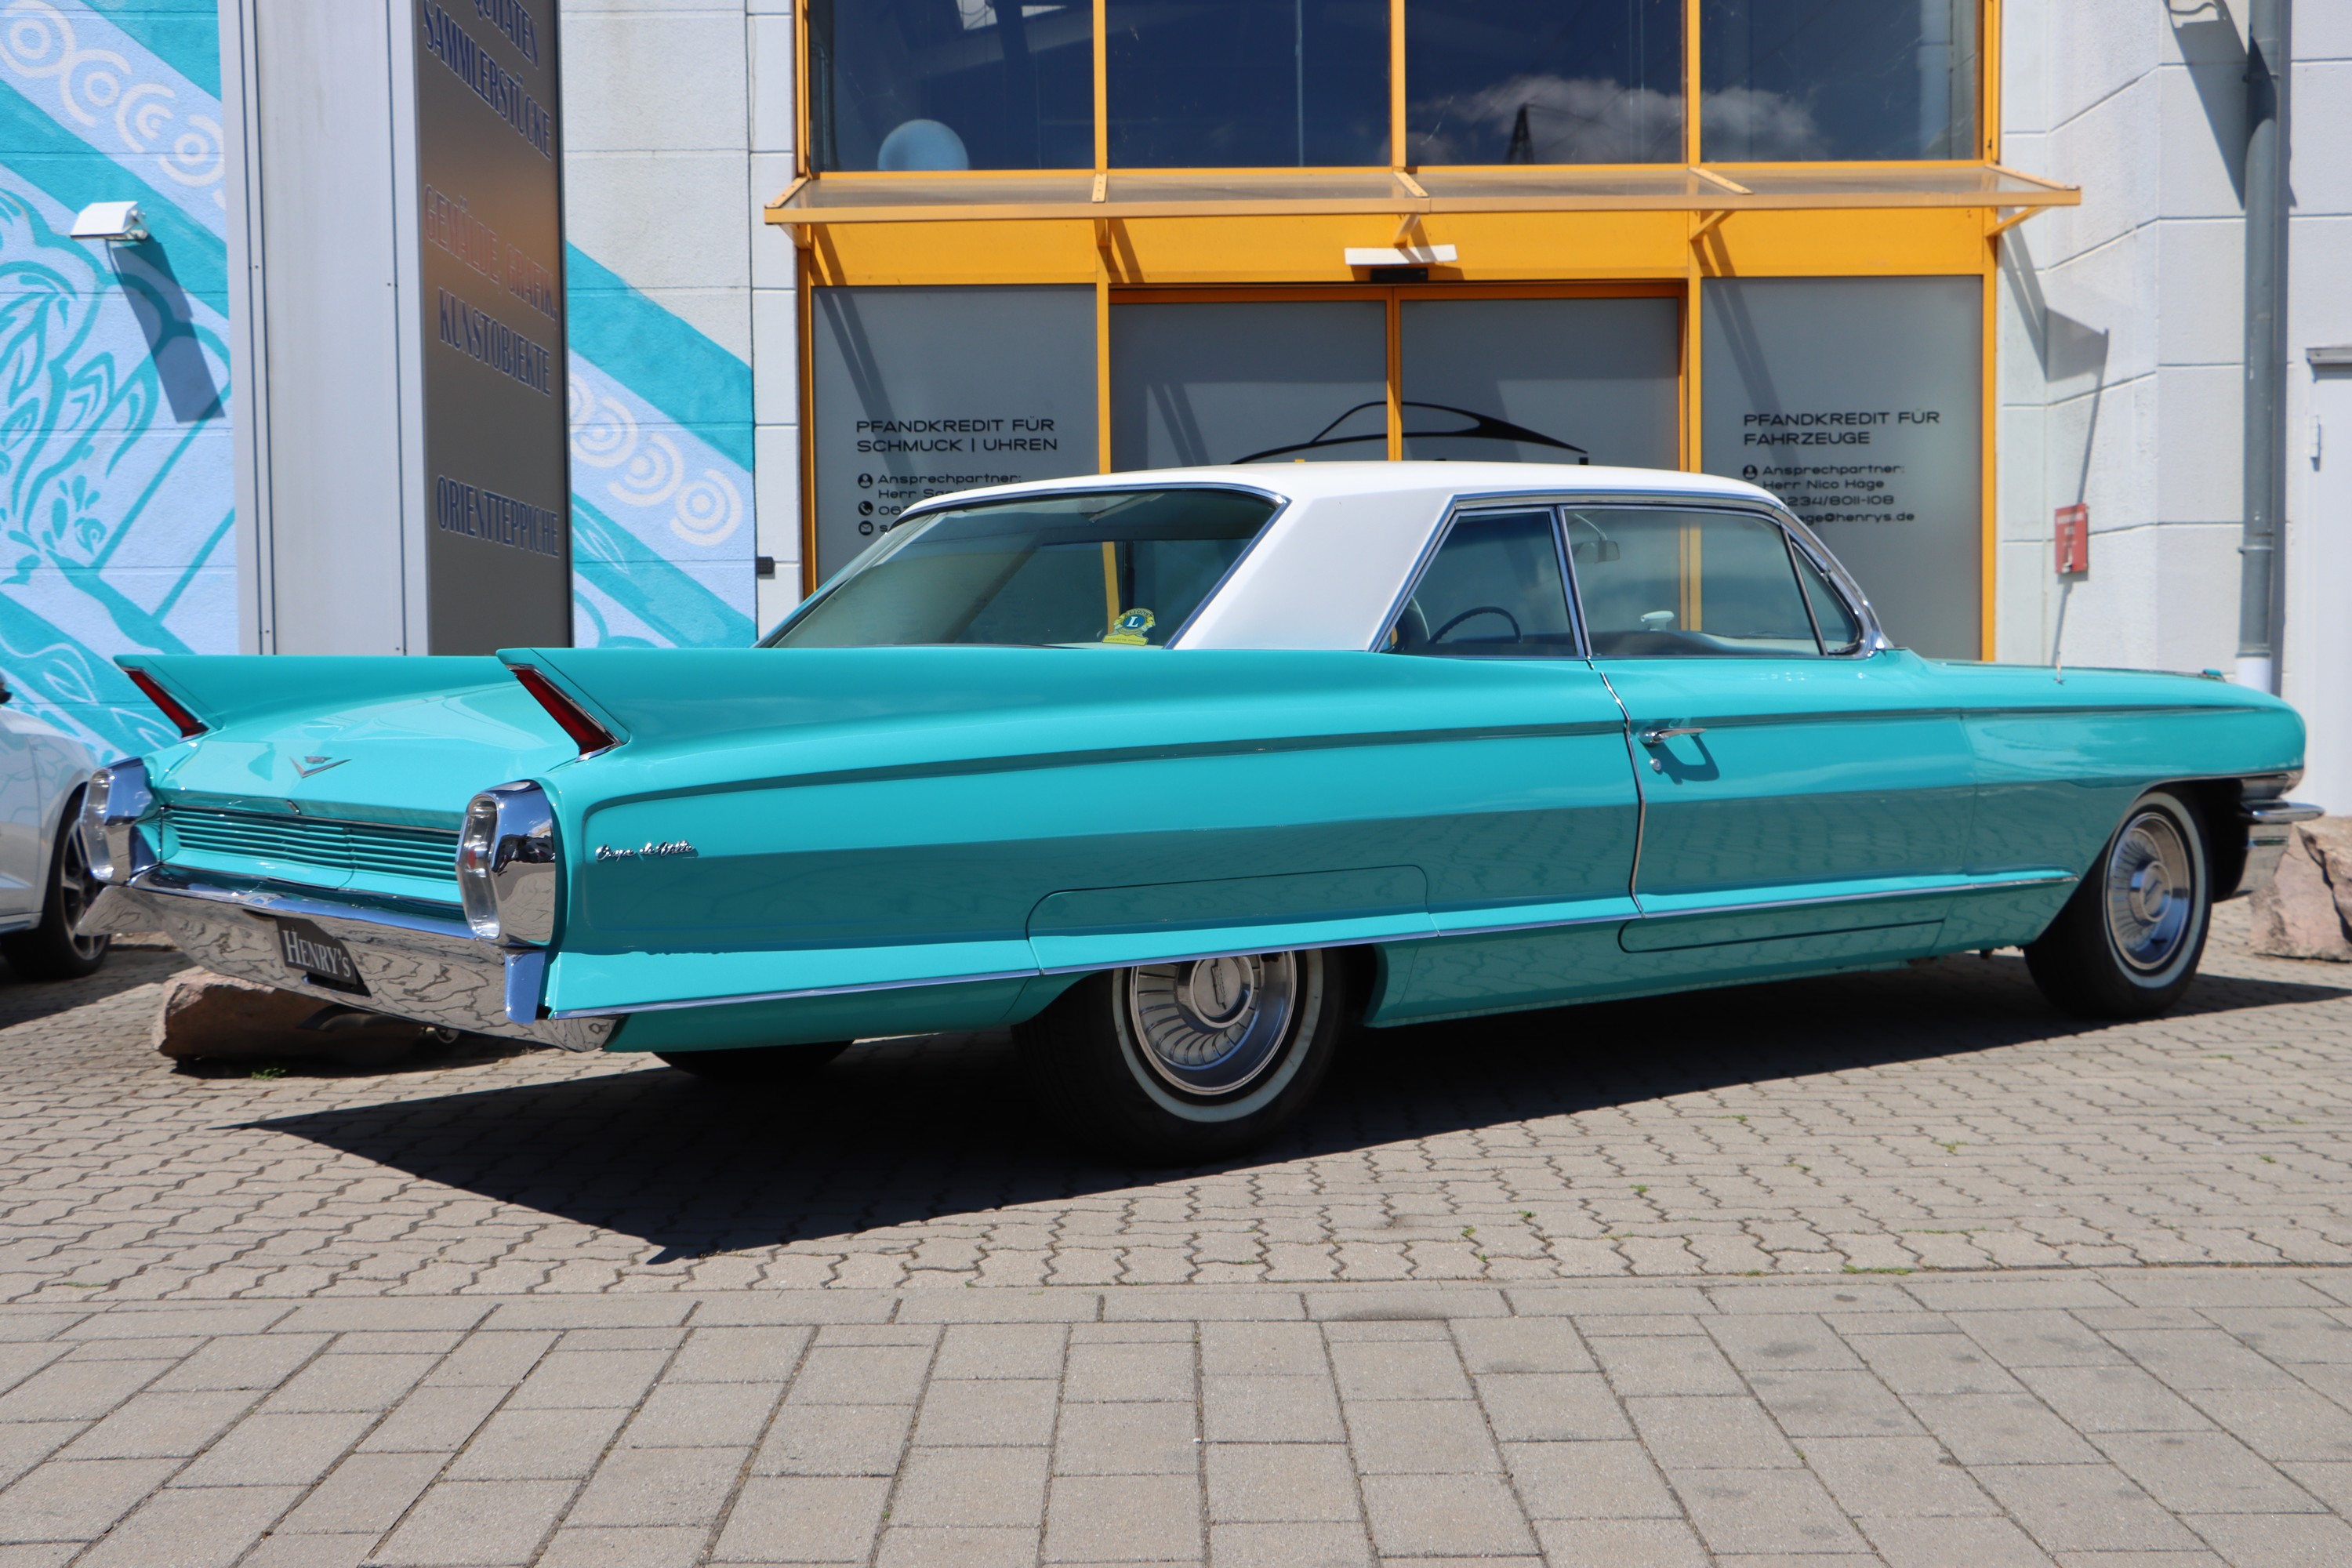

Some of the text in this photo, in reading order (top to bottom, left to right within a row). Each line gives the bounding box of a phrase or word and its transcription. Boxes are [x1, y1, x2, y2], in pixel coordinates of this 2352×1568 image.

[423, 0, 552, 162] SAMMLERSTÜCKE
[425, 183, 502, 295] GEMÄLDE,
[438, 286, 551, 397] KUNSTOBJEKTE
[1744, 408, 1940, 426] PFANDKREDIT FÜR
[856, 416, 1055, 433] PFANDKREDIT FÜR
[857, 439, 963, 452] SCHMUCK
[983, 438, 1058, 451] UHREN
[1744, 431, 1871, 445] FAHRZEUGE
[1762, 464, 1905, 477] Ansprechpartner:
[878, 474, 1022, 485] Ansprechpartner:
[1763, 480, 1801, 490] Herr
[1806, 479, 1839, 490] Nico
[878, 488, 916, 499] Herr
[437, 474, 559, 559] ORIENTTEPPICHE
[1127, 616, 1138, 627] L
